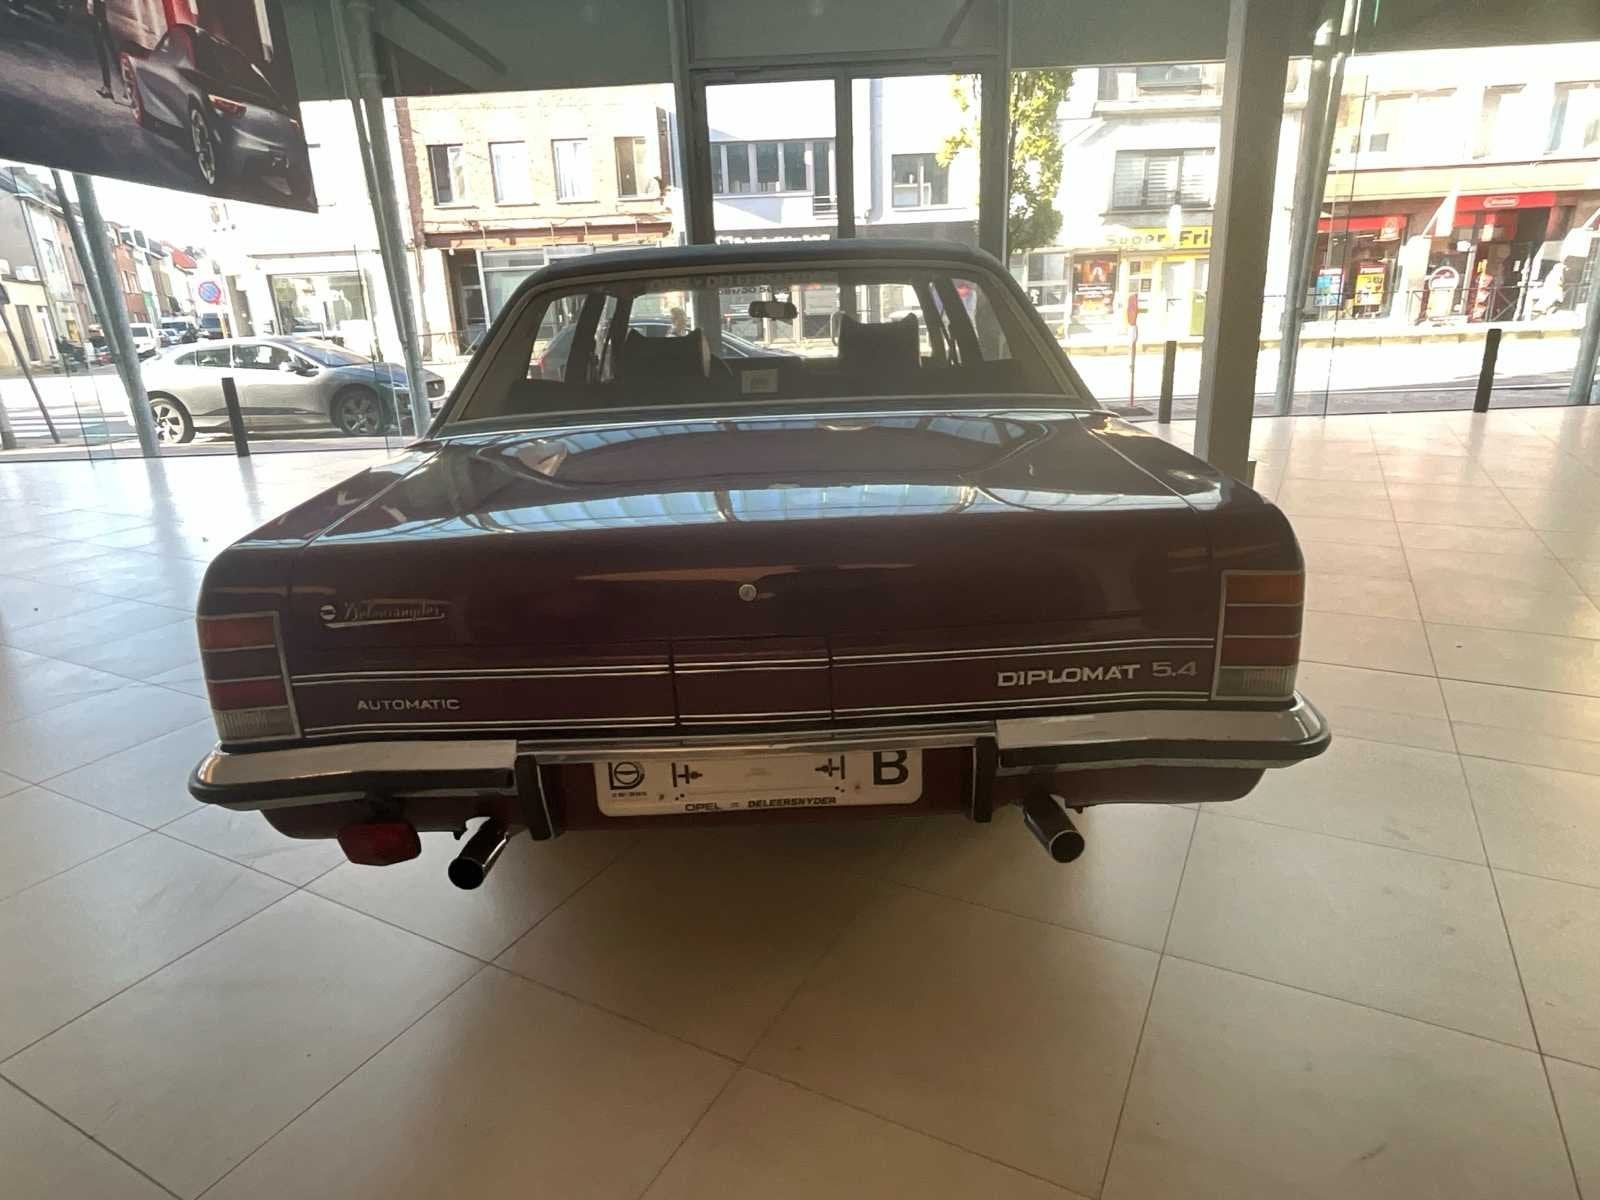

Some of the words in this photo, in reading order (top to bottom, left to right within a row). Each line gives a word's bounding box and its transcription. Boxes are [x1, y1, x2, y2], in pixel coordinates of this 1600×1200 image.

[1179, 229, 1211, 246] Fri
[997, 664, 1141, 687] DIPLOMAT
[1152, 660, 1199, 677] 5.4
[357, 698, 461, 711] AUTOMATIC
[872, 750, 909, 786] B
[685, 802, 722, 812] OPEL
[747, 796, 837, 809] DELEERSNYDER
